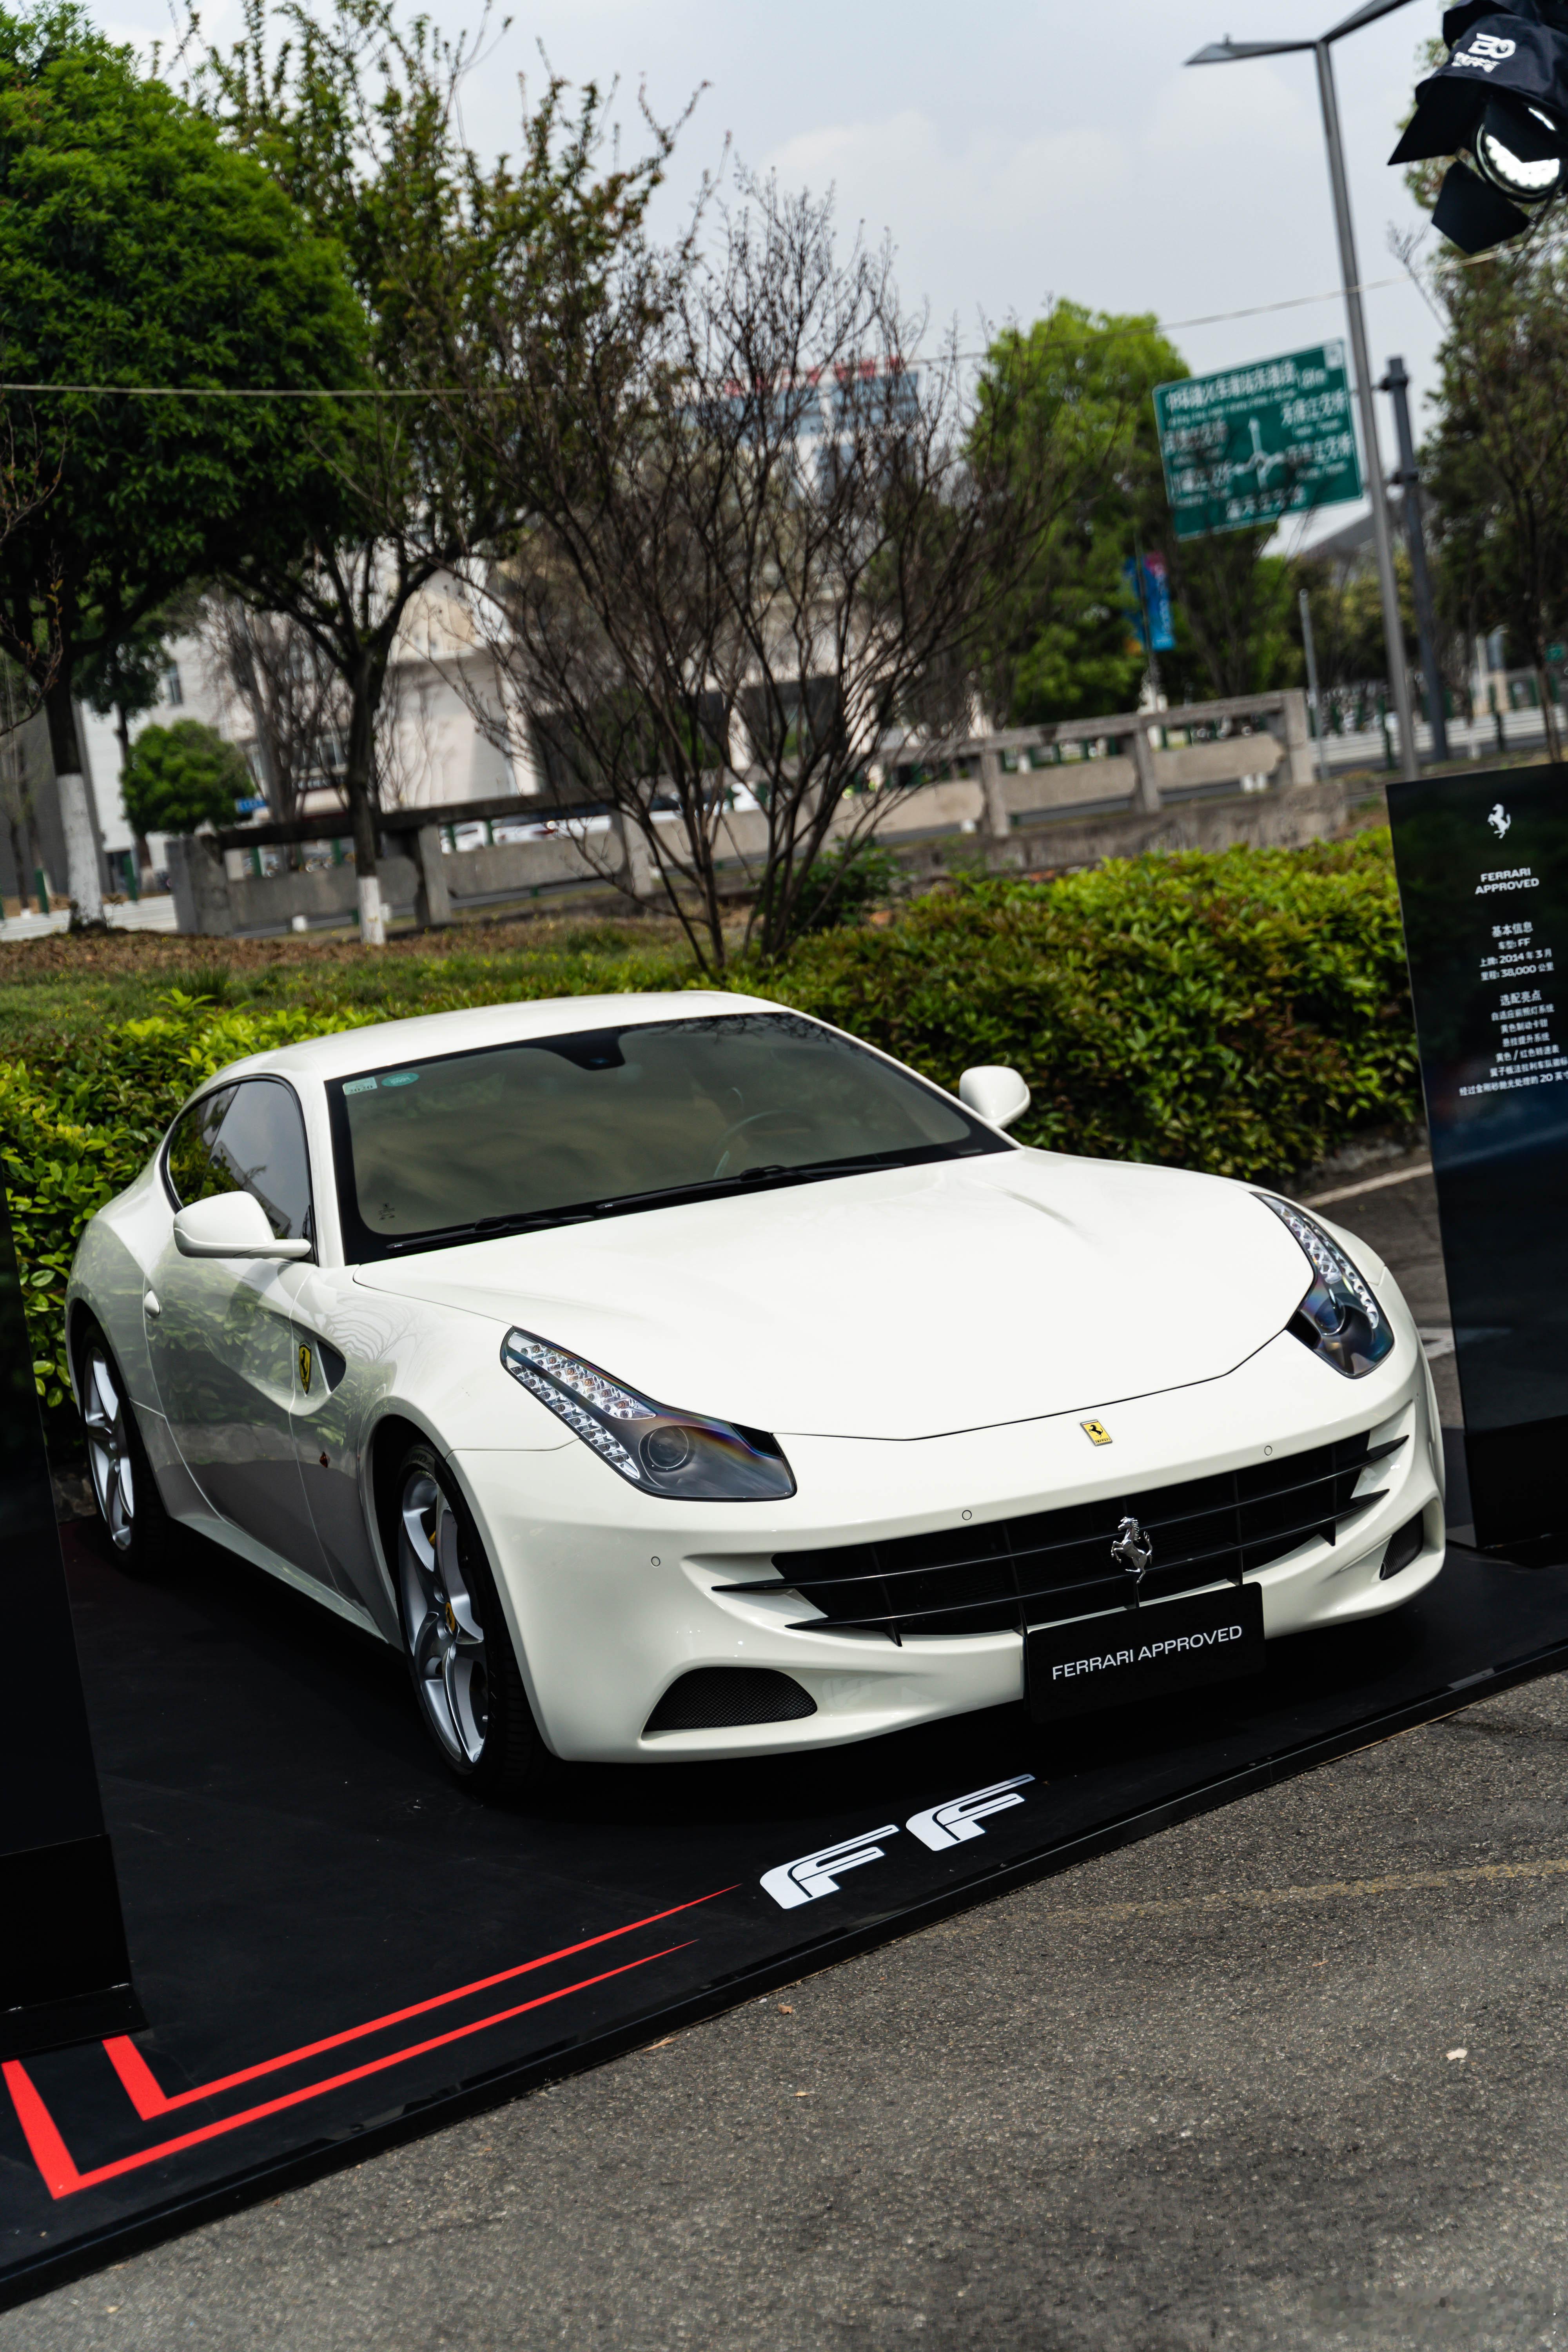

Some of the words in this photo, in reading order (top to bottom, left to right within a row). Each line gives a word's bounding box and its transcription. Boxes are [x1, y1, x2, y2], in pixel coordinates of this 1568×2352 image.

[1480, 867, 1531, 882] FERRARI
[1475, 878, 1539, 895] APPROVED
[1491, 921, 1534, 937] 基本信息
[1517, 938, 1531, 947] FF
[1499, 952, 1524, 964] 2014
[1535, 950, 1543, 959] 3
[1544, 948, 1552, 958] 月
[1500, 965, 1537, 978] 38,000
[1499, 989, 1542, 1006] 选配亮点
[1540, 1073, 1553, 1083] 20
[1053, 1649, 1133, 1680] FERRARI
[1138, 1625, 1242, 1661] APPROVED
